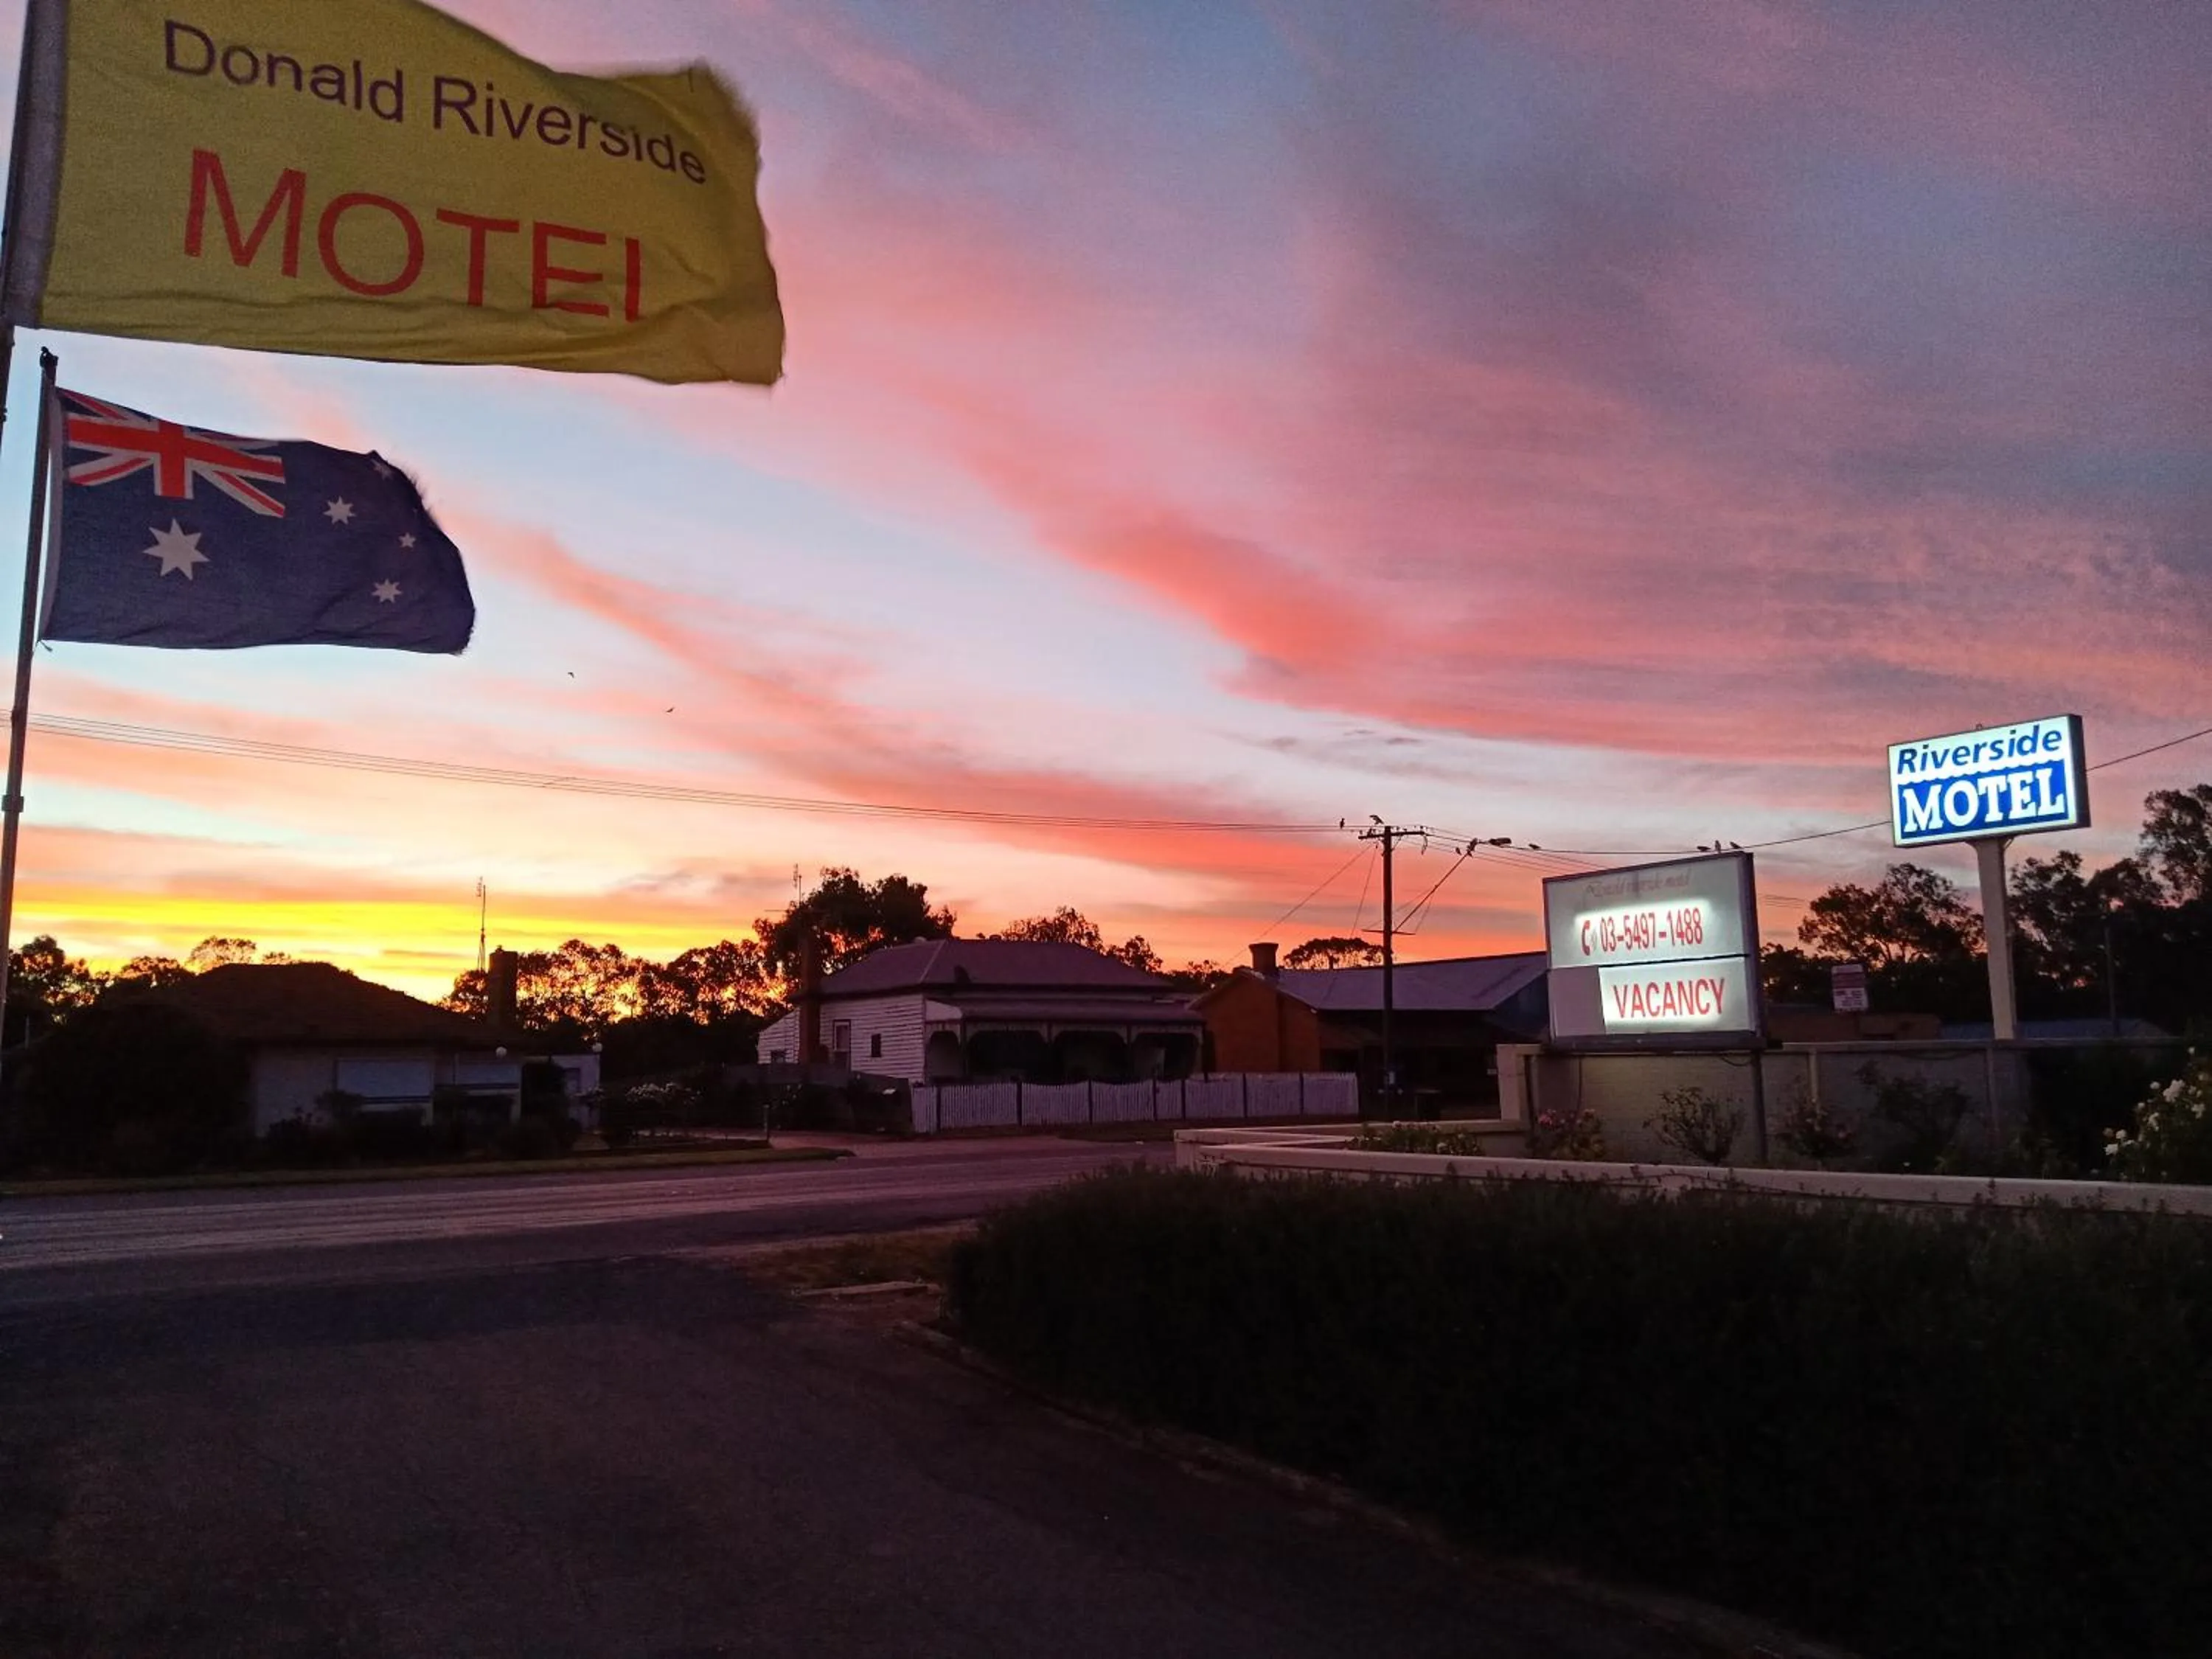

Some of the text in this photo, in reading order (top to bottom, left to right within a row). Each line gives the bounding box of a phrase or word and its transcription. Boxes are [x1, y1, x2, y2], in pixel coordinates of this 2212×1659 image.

[164, 19, 707, 185] Donald Riverside
[1897, 724, 2063, 775] Riverside
[1902, 768, 2065, 832] MOTEL
[1599, 908, 1703, 953] 03-5497-1488
[1613, 978, 1725, 1018] VACANCY
